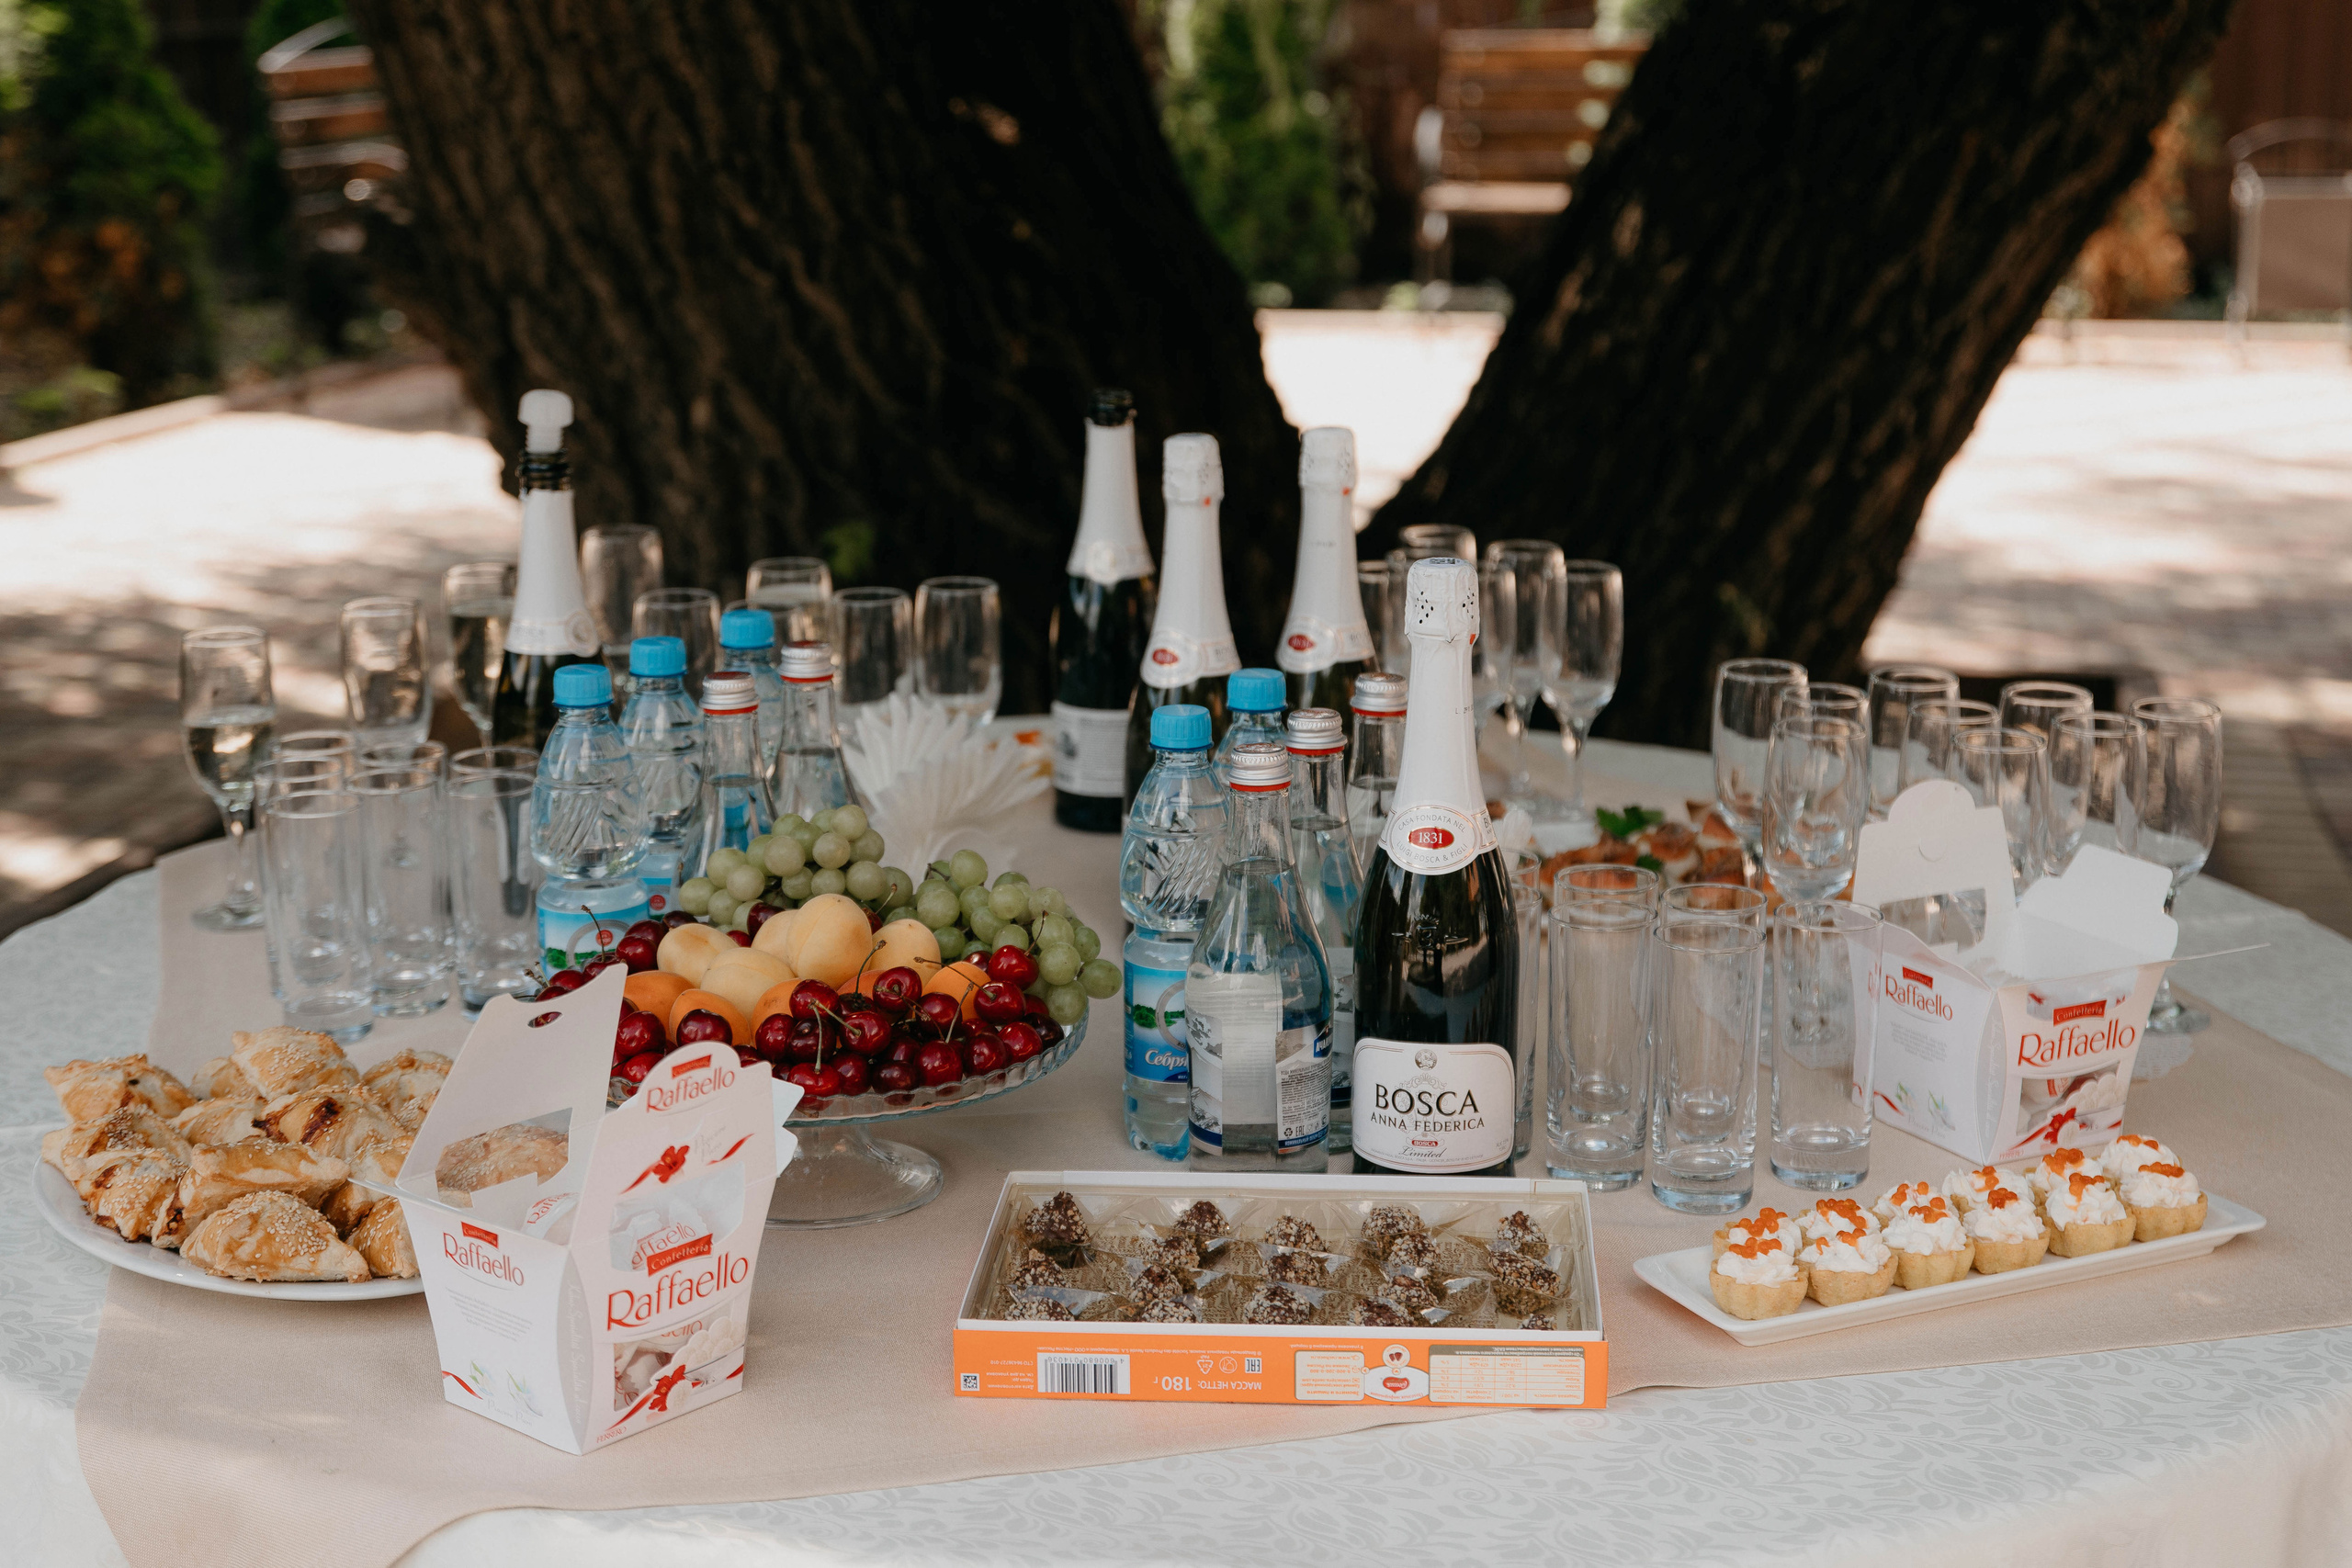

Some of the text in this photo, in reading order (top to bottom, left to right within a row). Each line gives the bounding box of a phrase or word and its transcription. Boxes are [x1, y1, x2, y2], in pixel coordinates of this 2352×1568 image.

[1397, 814, 1466, 833] CASA FONDATA NEL
[1419, 831, 1443, 844] 1831
[1396, 840, 1469, 863] LUIGI BOSCA & FIGLI
[1885, 974, 1953, 1021] Raffaello
[2056, 1005, 2103, 1022] Confetteria
[2018, 1018, 2136, 1068] Raffaello
[1145, 1049, 1188, 1070] Себря
[646, 1066, 735, 1113] Raffaello
[1375, 1083, 1480, 1117] BOSCA
[1371, 1111, 1486, 1133] ANNA FEDERICA
[1398, 1145, 1448, 1159] Limited
[632, 1223, 695, 1266] affaello
[443, 1232, 525, 1286] Raffaello
[651, 1244, 708, 1270] Confetteria
[607, 1251, 749, 1332] Raffaello
[1246, 1359, 1261, 1372] EAC
[1153, 1376, 1261, 1392] МАССА НЕТТО: 180 г
